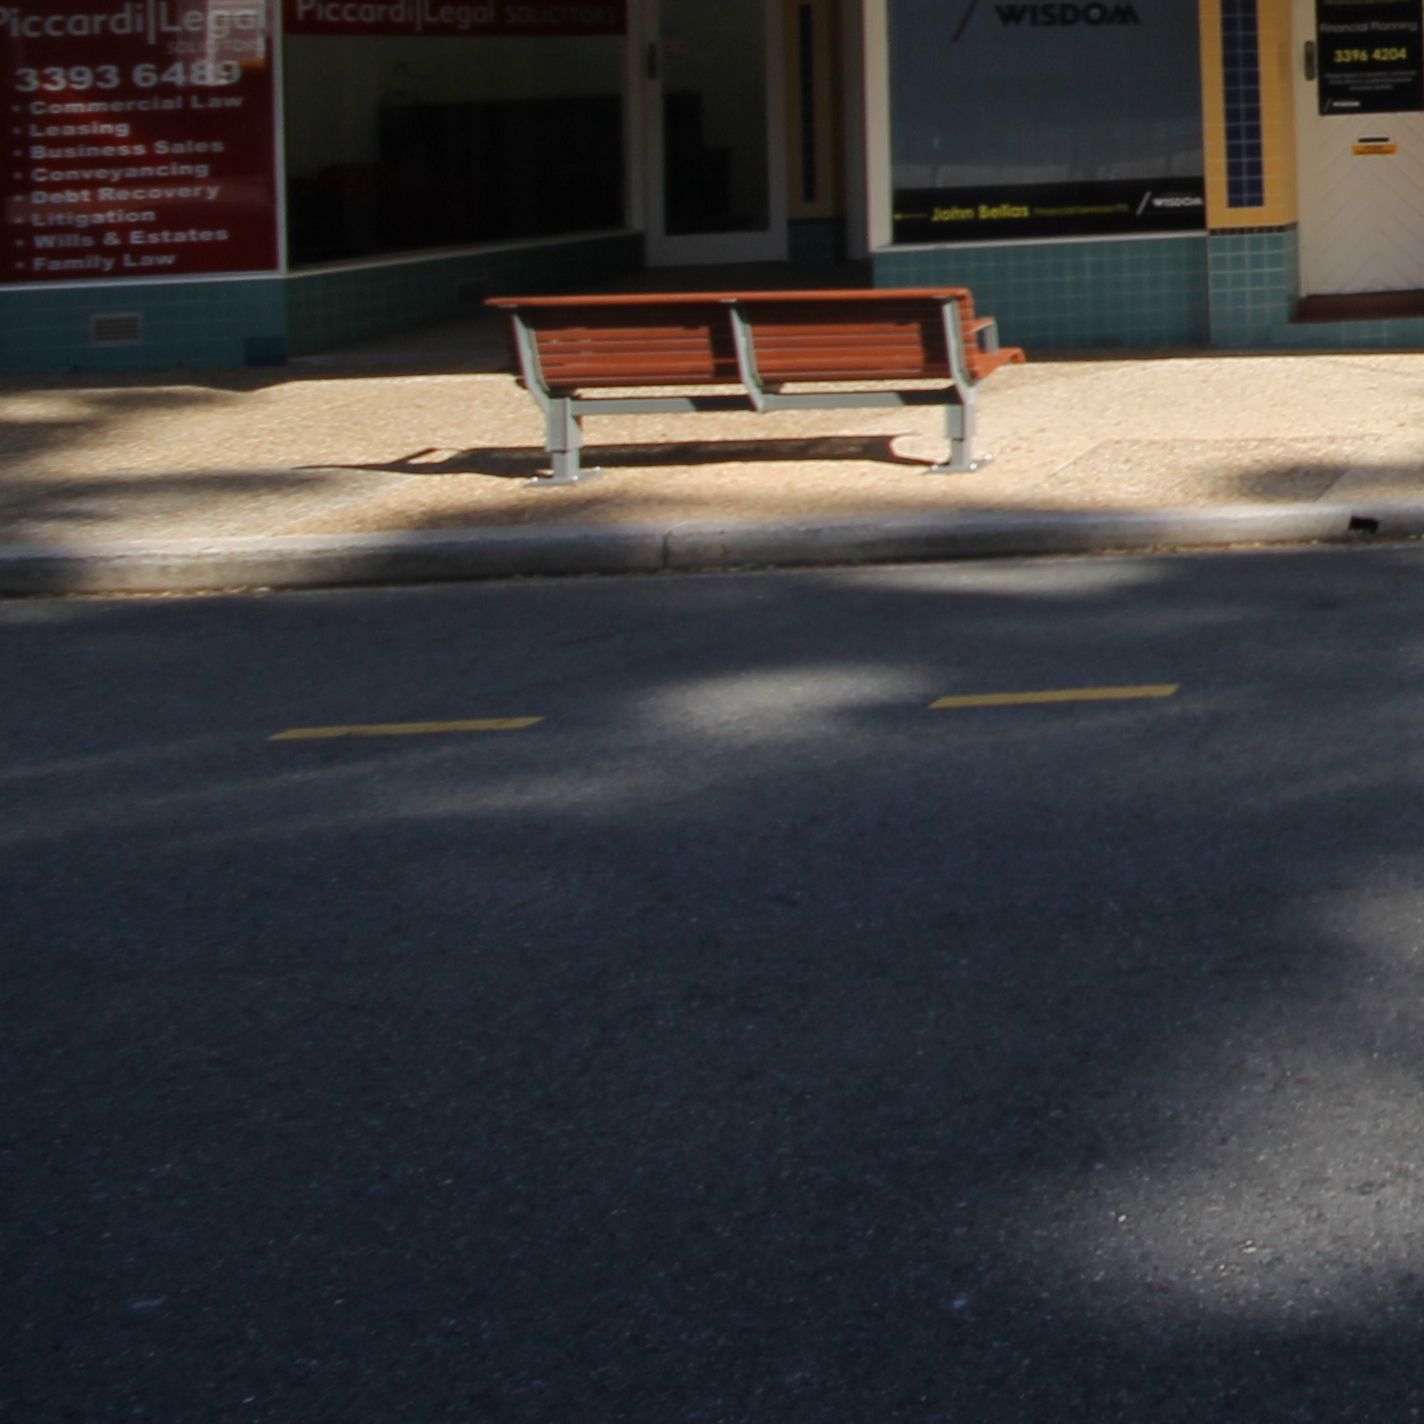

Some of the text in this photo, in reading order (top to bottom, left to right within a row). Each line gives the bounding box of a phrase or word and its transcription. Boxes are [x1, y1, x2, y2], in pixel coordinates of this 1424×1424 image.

[993, 0, 1142, 27] WISDOM
[1333, 46, 1407, 63] 3396 4204
[14, 59, 243, 93] 3393 6489
[28, 93, 244, 116] Commercial Law
[28, 120, 132, 138] Leasing
[29, 139, 226, 160] Business Sales
[30, 162, 212, 183] Conveyancing
[30, 184, 221, 205] Debt Recovery
[30, 208, 157, 229] Litigation
[931, 205, 975, 223] John
[979, 203, 1030, 219] Bellas
[32, 228, 230, 249] Wills & Estates
[32, 251, 177, 273] Family Law
